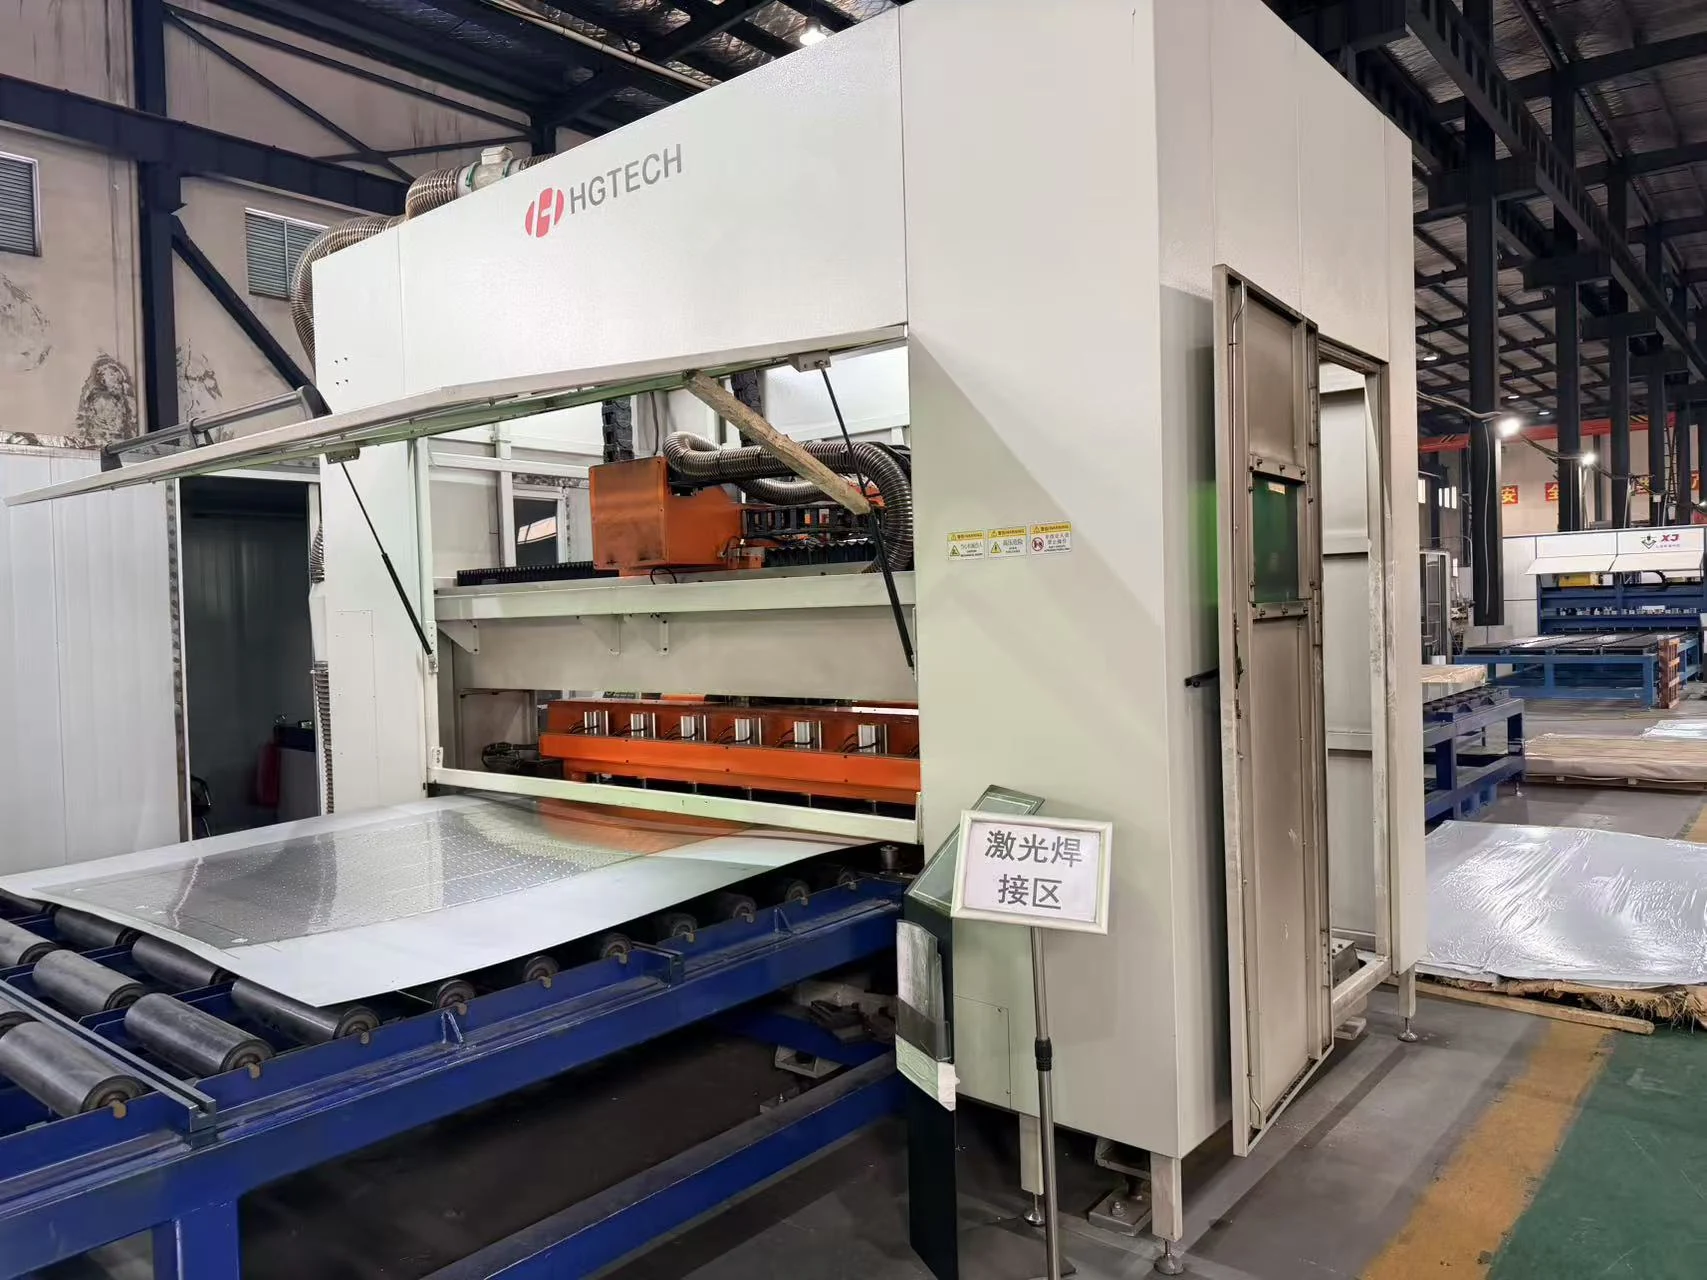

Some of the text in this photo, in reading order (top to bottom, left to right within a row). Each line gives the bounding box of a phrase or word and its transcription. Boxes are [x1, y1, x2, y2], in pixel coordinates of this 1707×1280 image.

[570, 143, 682, 214] HGTECH
[985, 830, 1083, 868] 激光焊
[998, 873, 1063, 910] 接区
